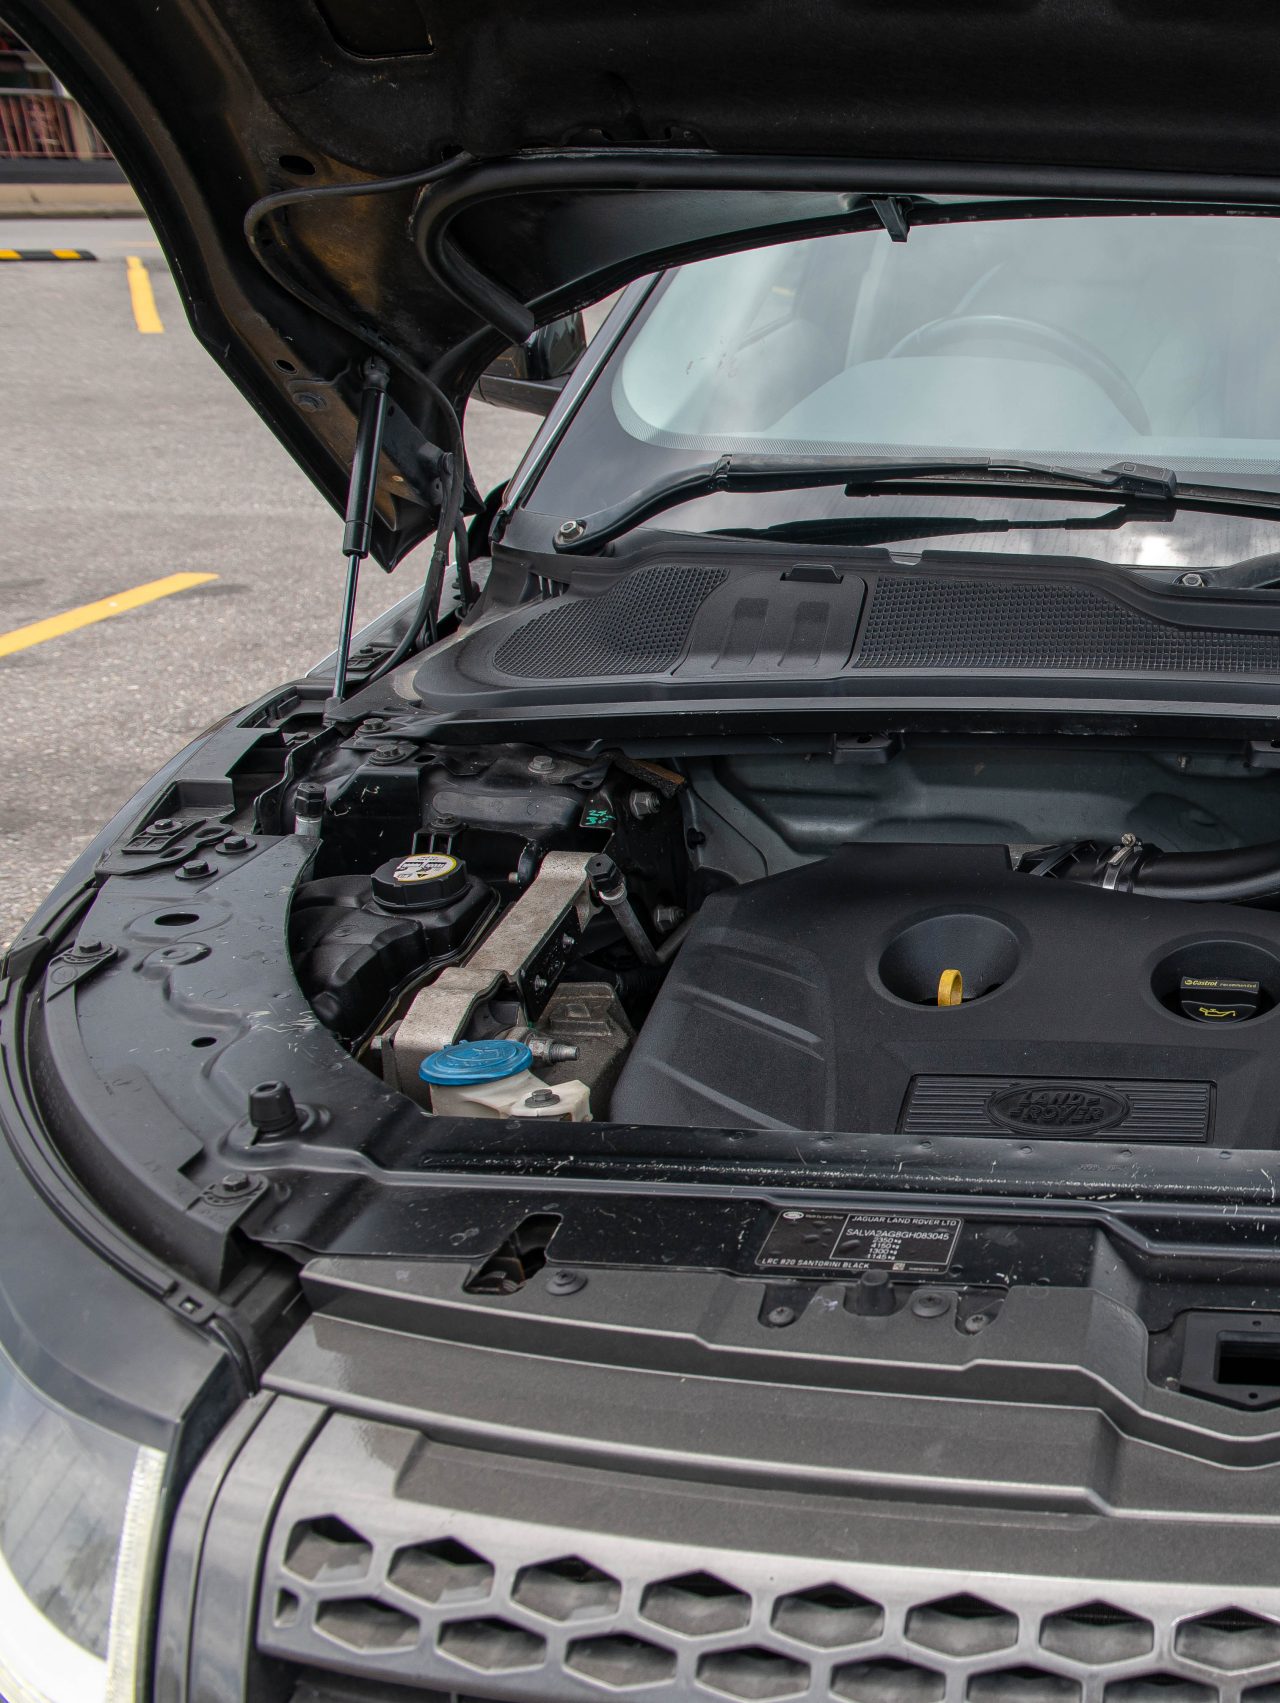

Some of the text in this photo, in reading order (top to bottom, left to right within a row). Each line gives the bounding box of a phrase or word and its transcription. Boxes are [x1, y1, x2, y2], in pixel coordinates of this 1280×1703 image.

[1024, 1105, 1105, 1122] ROVER
[797, 1259, 841, 1267] SANTORINI
[842, 1260, 870, 1268] BLACK
